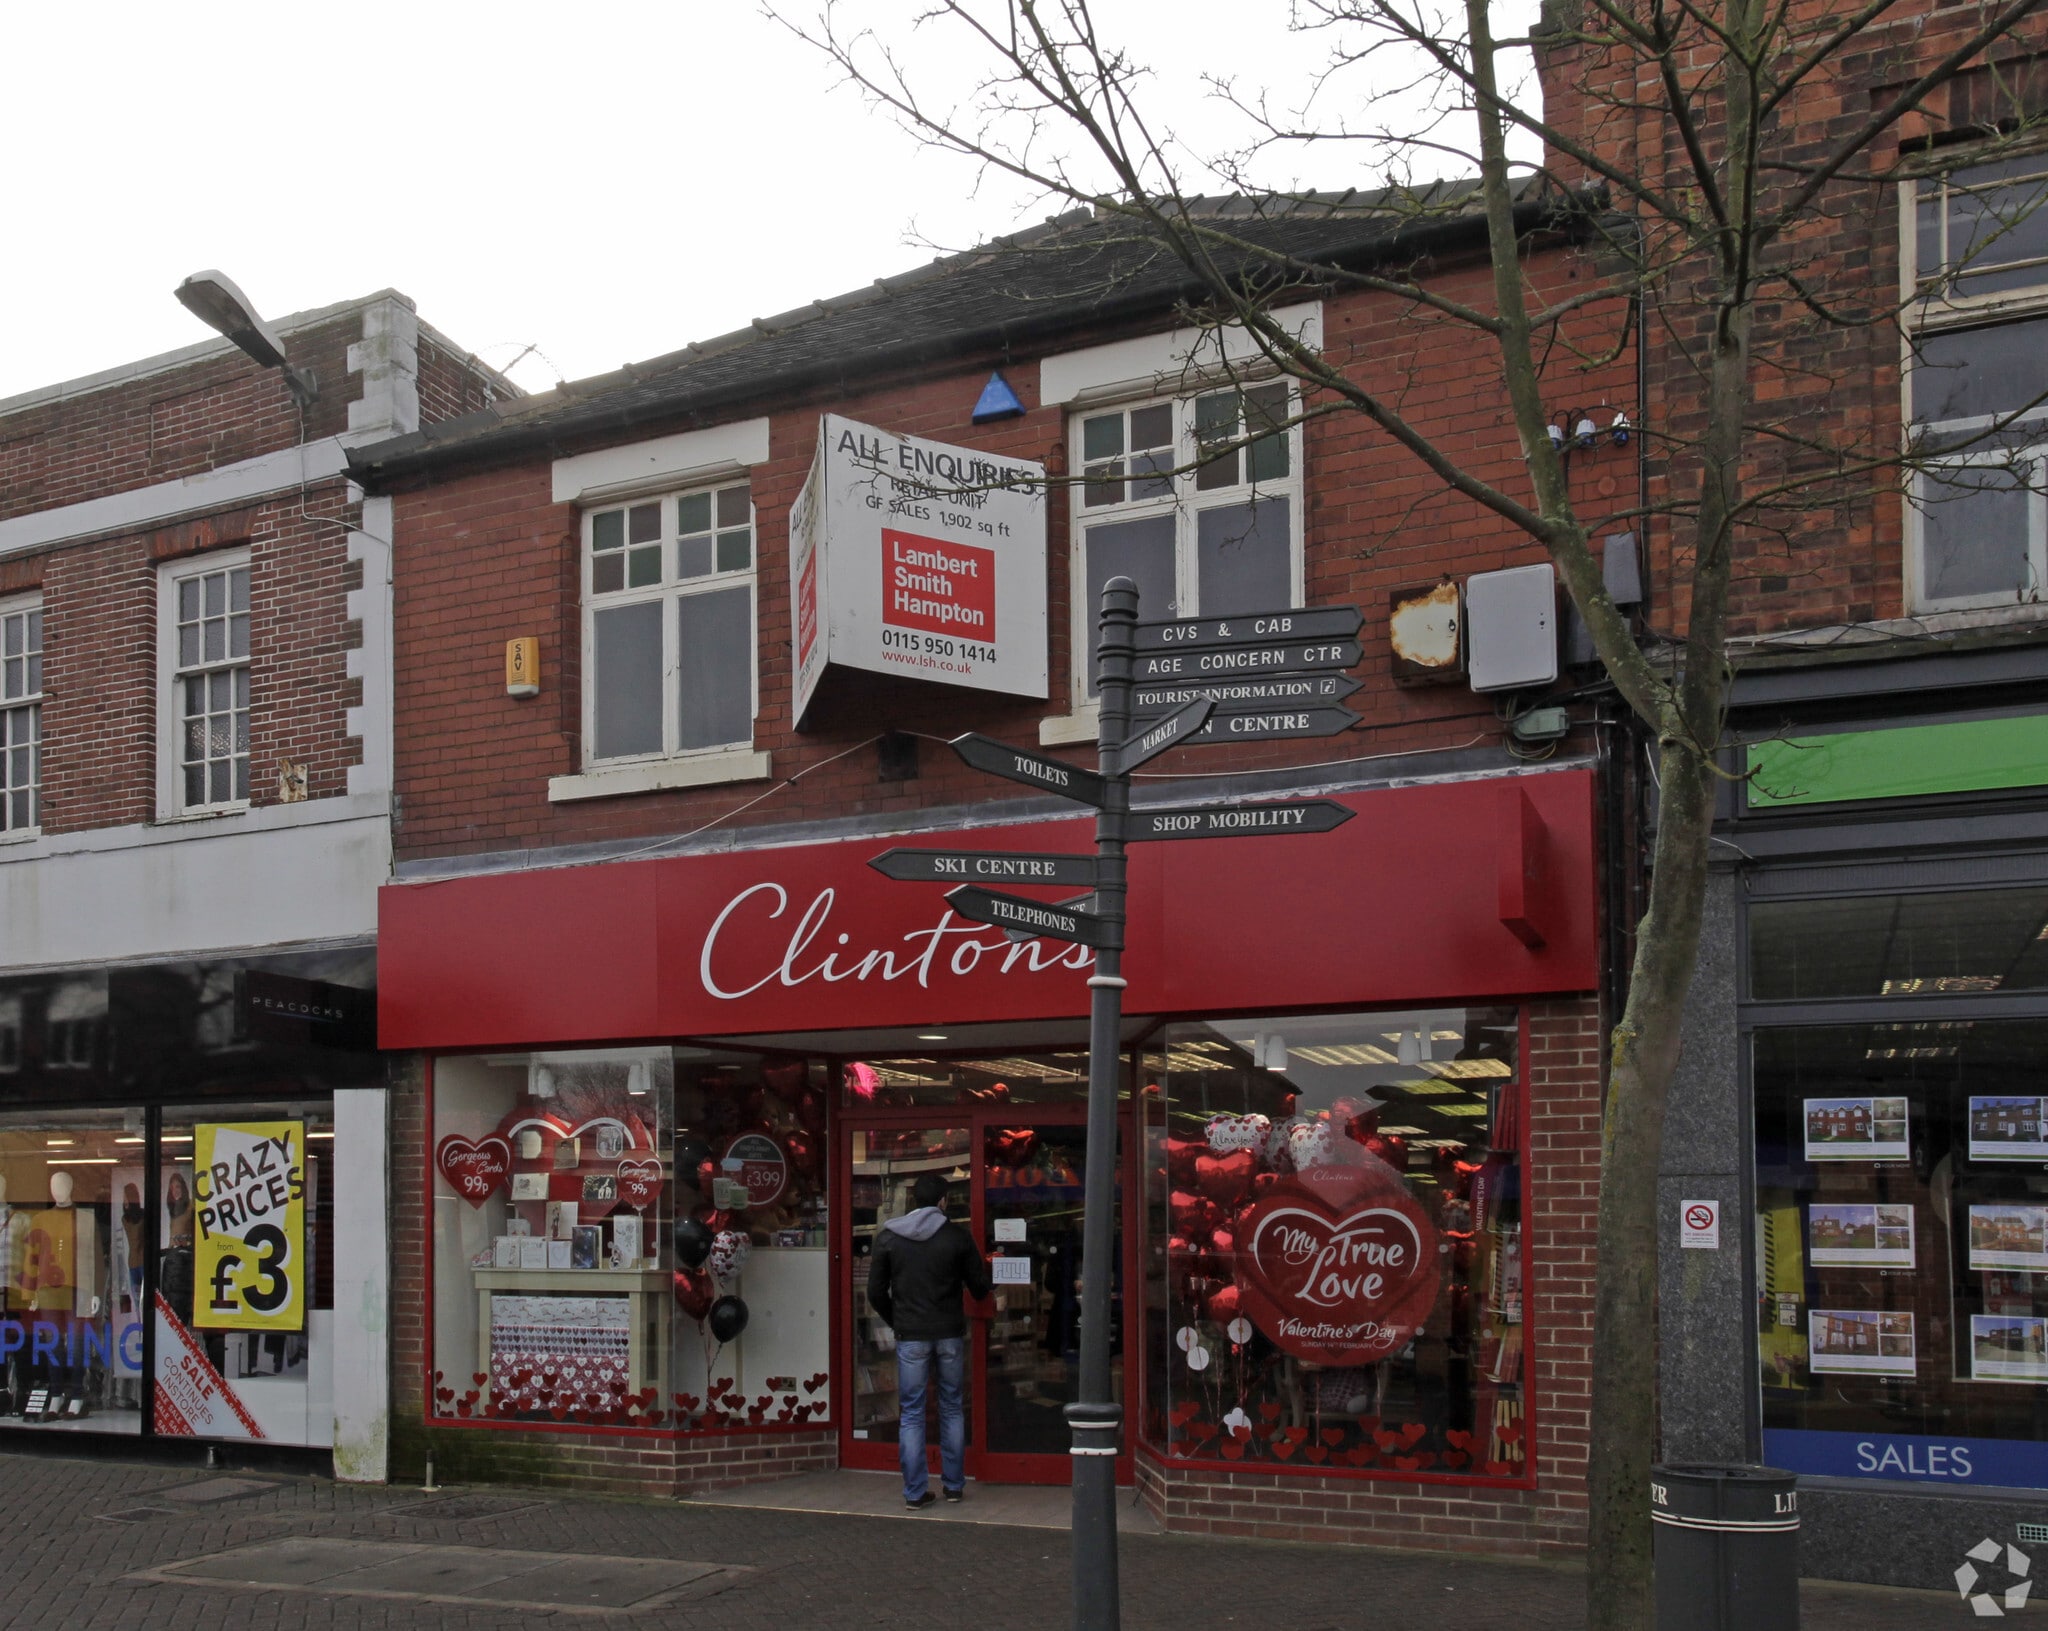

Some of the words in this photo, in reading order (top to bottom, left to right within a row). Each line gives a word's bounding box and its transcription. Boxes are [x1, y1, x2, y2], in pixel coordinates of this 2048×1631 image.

[837, 429, 888, 465] ALL
[900, 443, 1036, 496] ENQUIRIES
[890, 475, 942, 501] RETAIL
[866, 495, 883, 510] GF
[889, 500, 930, 520] SALES
[939, 510, 972, 530] 1,902
[977, 521, 993, 537] sq
[998, 522, 1011, 537] ft
[893, 541, 978, 578] Lambert
[894, 566, 952, 597] Smith
[894, 588, 984, 627] Hampton
[1162, 625, 1198, 642] CVS
[1218, 622, 1232, 638] &
[1255, 618, 1293, 634] CAB
[882, 630, 919, 651] 0115
[924, 637, 954, 657] 950
[958, 643, 997, 664] 1414
[882, 650, 972, 675] www.lsh.co.uk
[1148, 658, 1183, 674] AGE
[1200, 650, 1285, 670] CONCERN
[1304, 646, 1342, 662] CTR
[1137, 689, 1200, 706] TOURIST
[1205, 682, 1313, 701] INFORMATION
[1141, 717, 1179, 753] MARKET
[1230, 714, 1310, 733] CENTRE
[1014, 756, 1069, 787] TOILETS
[1153, 815, 1201, 832] SHOP
[1209, 809, 1306, 829] MOBILITY
[934, 857, 967, 873] SKI
[976, 858, 1056, 876] CENTRE
[991, 900, 1076, 933] TELEPHONES
[700, 882, 1095, 1000] Clintons
[252, 996, 343, 1019] PEACOCKS
[193, 1129, 291, 1203] CRAZY
[447, 1149, 491, 1168] Gorgeous
[475, 1161, 503, 1175] Cards
[620, 1166, 650, 1179] Gorgeous
[464, 1176, 489, 1195] 99p
[631, 1183, 648, 1195] 99p
[747, 1170, 780, 1188] £3.99
[1478, 1177, 1486, 1190] DAY
[198, 1166, 305, 1241] PRICES
[1475, 1191, 1485, 1231] VALENTINE'S
[216, 1241, 235, 1252] from
[1273, 1225, 1320, 1265] My
[1329, 1228, 1404, 1267] True
[209, 1223, 289, 1312] £3
[1294, 1248, 1385, 1308] Love
[1277, 1318, 1353, 1338] Valentine's
[1356, 1321, 1397, 1349] Day
[164, 1356, 214, 1425] CONTINUES
[180, 1355, 214, 1401] SALE
[155, 1385, 169, 1405] SALE
[168, 1404, 183, 1423] SALE
[155, 1400, 170, 1420] SALE
[162, 1374, 200, 1426] INSTORE
[1856, 1441, 1972, 1477] SALES
